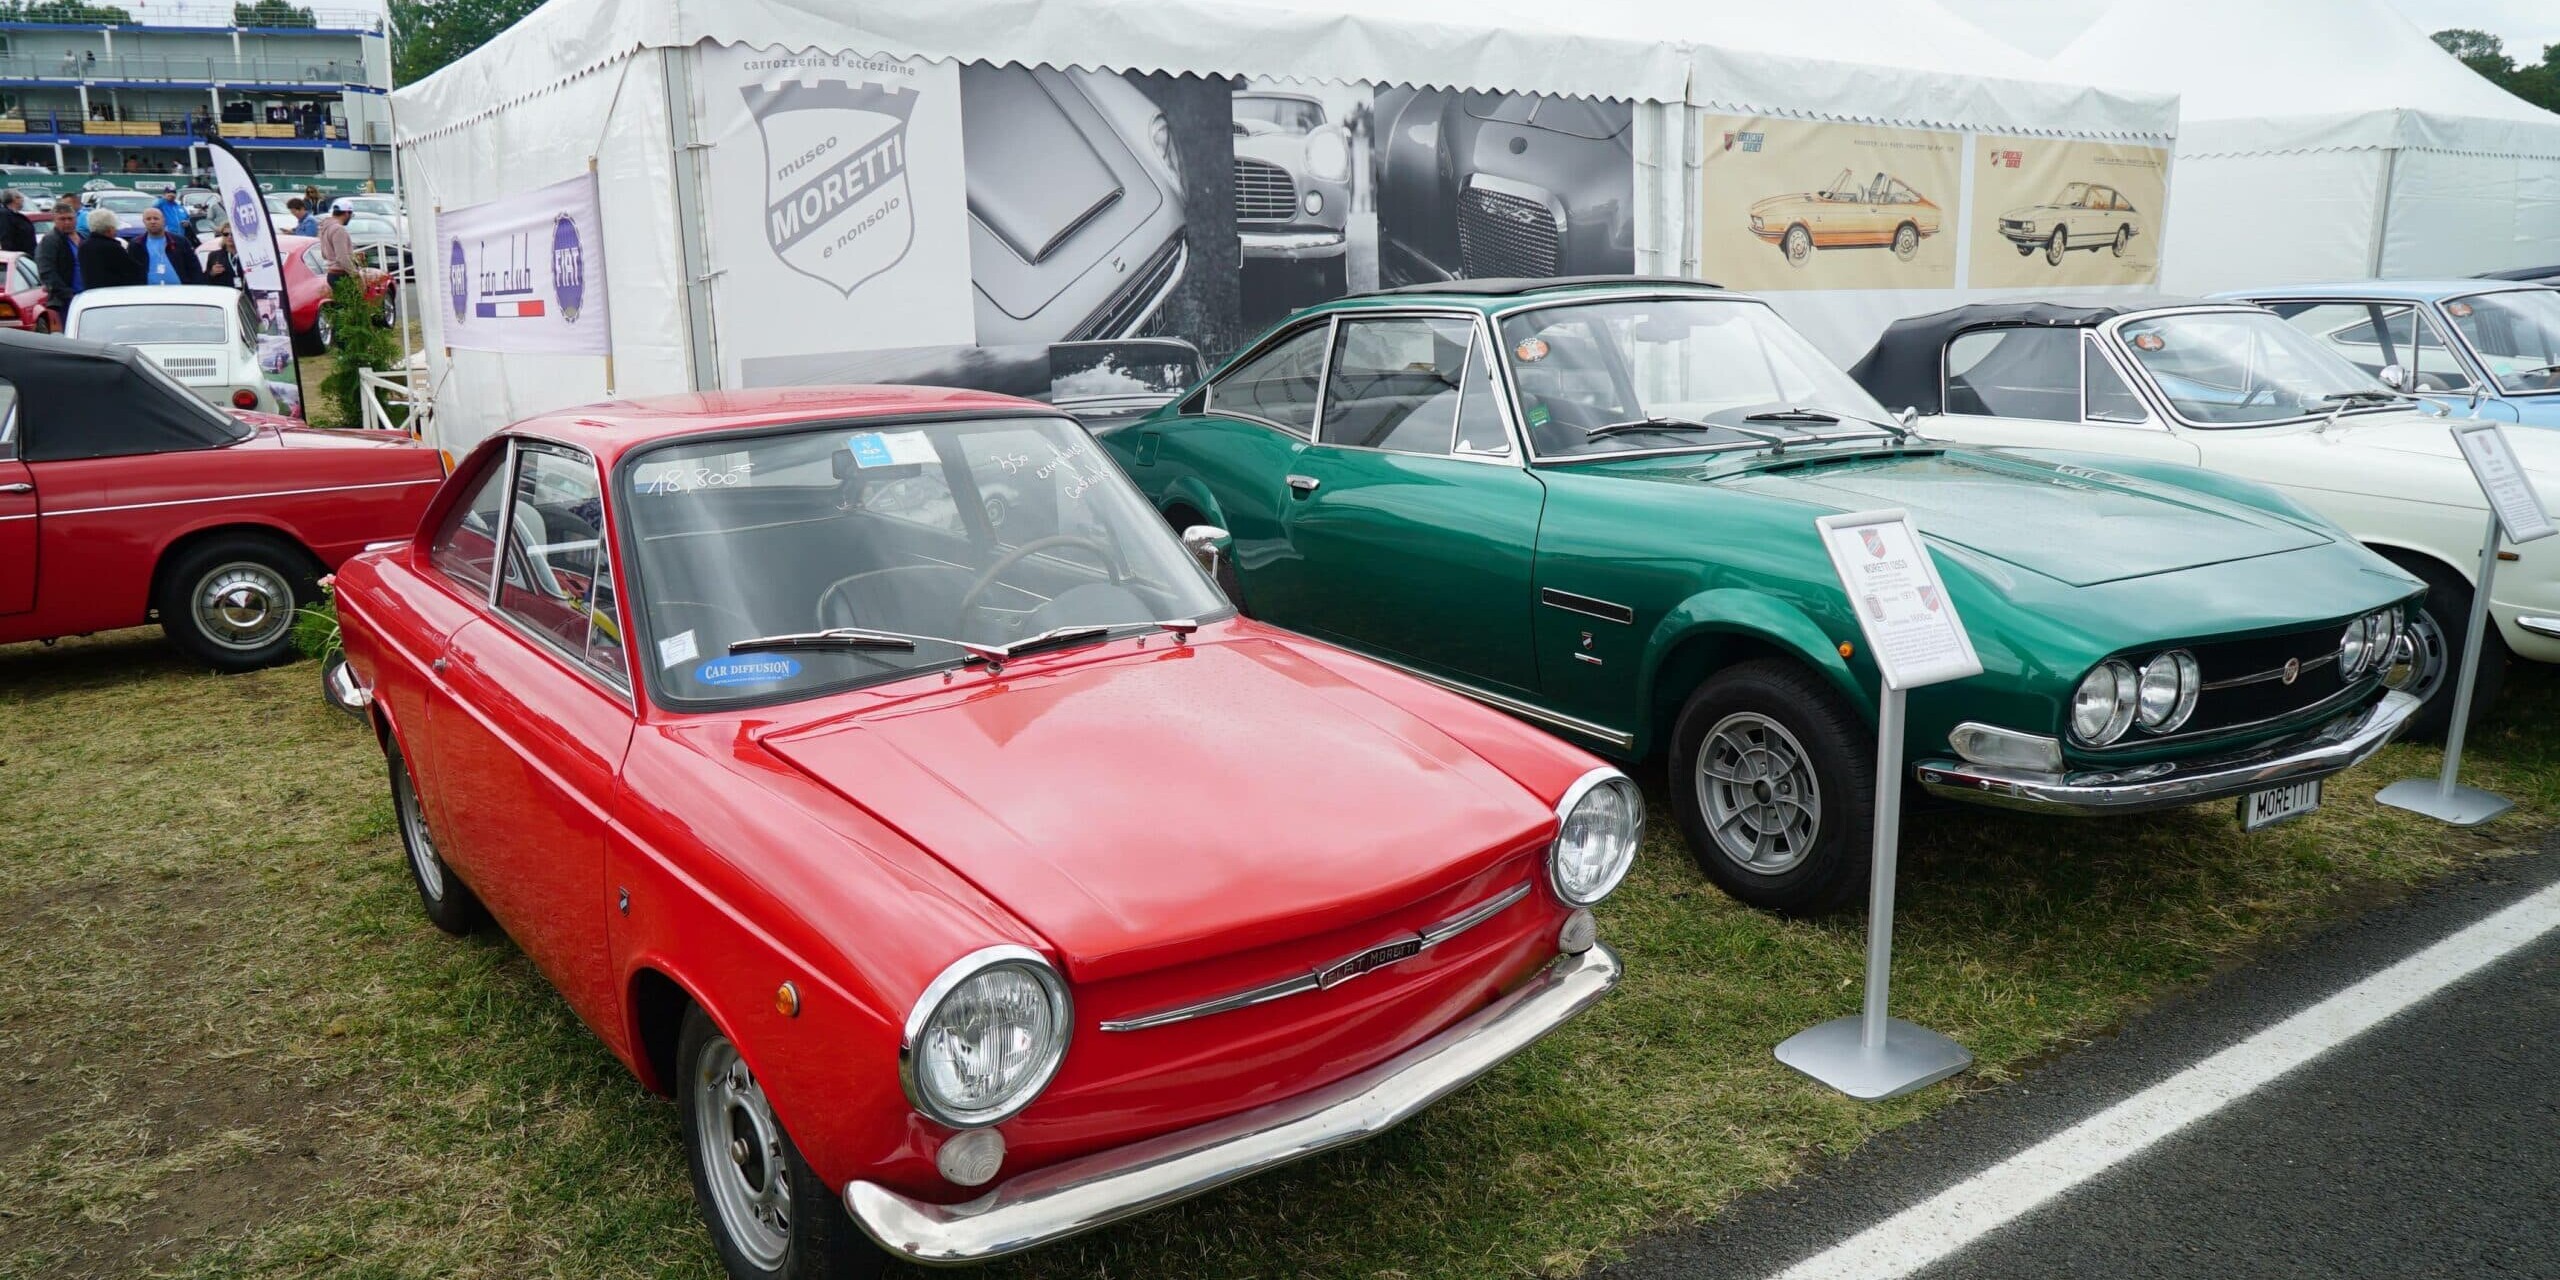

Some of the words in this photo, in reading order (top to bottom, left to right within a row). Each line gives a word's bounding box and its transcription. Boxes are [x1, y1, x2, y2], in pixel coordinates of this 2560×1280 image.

[743, 54, 826, 71] carrozzeria
[832, 55, 916, 76] d'eccezione
[777, 135, 837, 181] museo
[771, 132, 903, 246] MORETTI
[823, 246, 833, 259] e
[836, 197, 900, 249] nonsolo
[554, 247, 580, 288] FIAT
[705, 665, 727, 679] CAR
[731, 660, 790, 675] DIFFUSION
[2256, 781, 2310, 820] MORETTI
[1370, 943, 1416, 965] MORETTI
